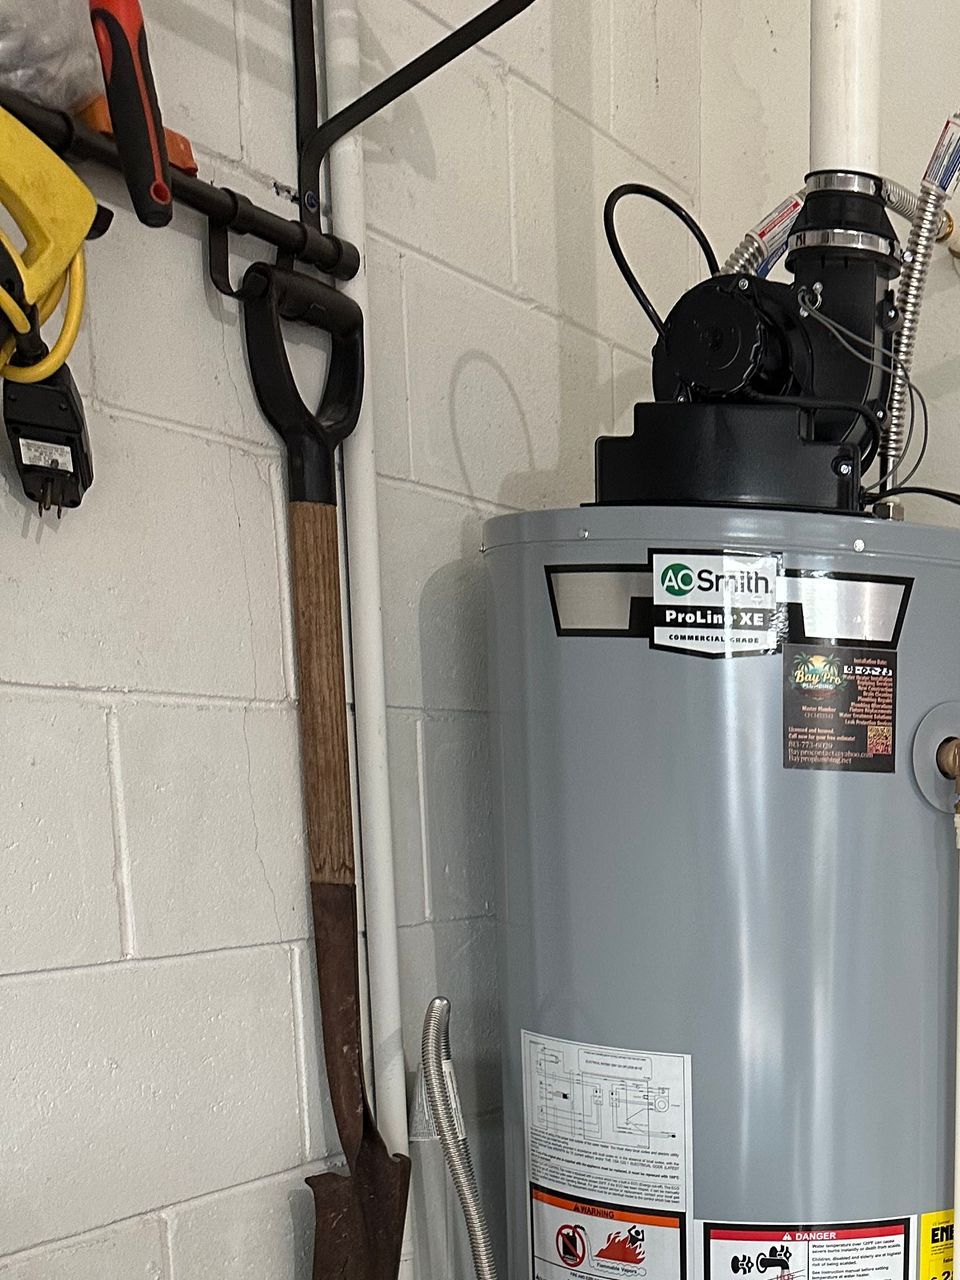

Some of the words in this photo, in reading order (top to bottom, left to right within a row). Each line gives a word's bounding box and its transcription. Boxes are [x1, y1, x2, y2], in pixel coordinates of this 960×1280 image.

[697, 569, 769, 594] Smith
[666, 609, 735, 624] ProLin
[740, 612, 764, 626] XE
[669, 634, 724, 643] COMMERCIAL
[730, 636, 759, 644] GRADE
[795, 670, 819, 684] Bay
[822, 672, 841, 684] Pro
[580, 1204, 615, 1219] WARNING
[795, 1232, 836, 1240] DANGER
[596, 1262, 620, 1271] Flammable
[621, 1266, 637, 1274] Vapors
